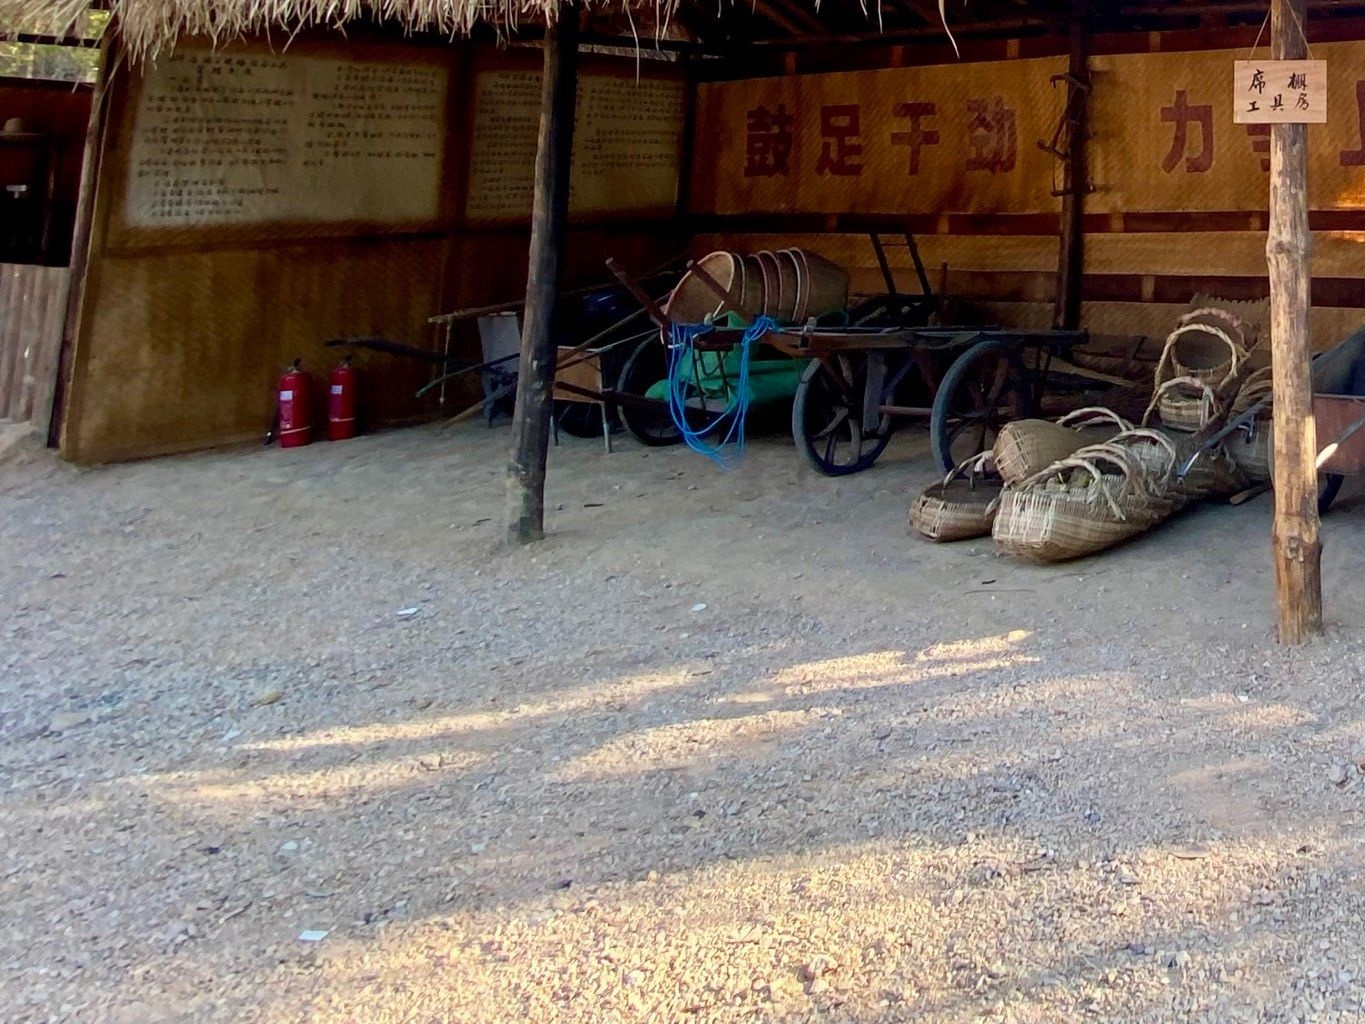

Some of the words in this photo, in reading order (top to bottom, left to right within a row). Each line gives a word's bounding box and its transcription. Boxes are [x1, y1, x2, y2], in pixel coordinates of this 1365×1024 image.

[1247, 93, 1310, 112] 工具房
[744, 97, 1017, 177] 鼓足干劲
